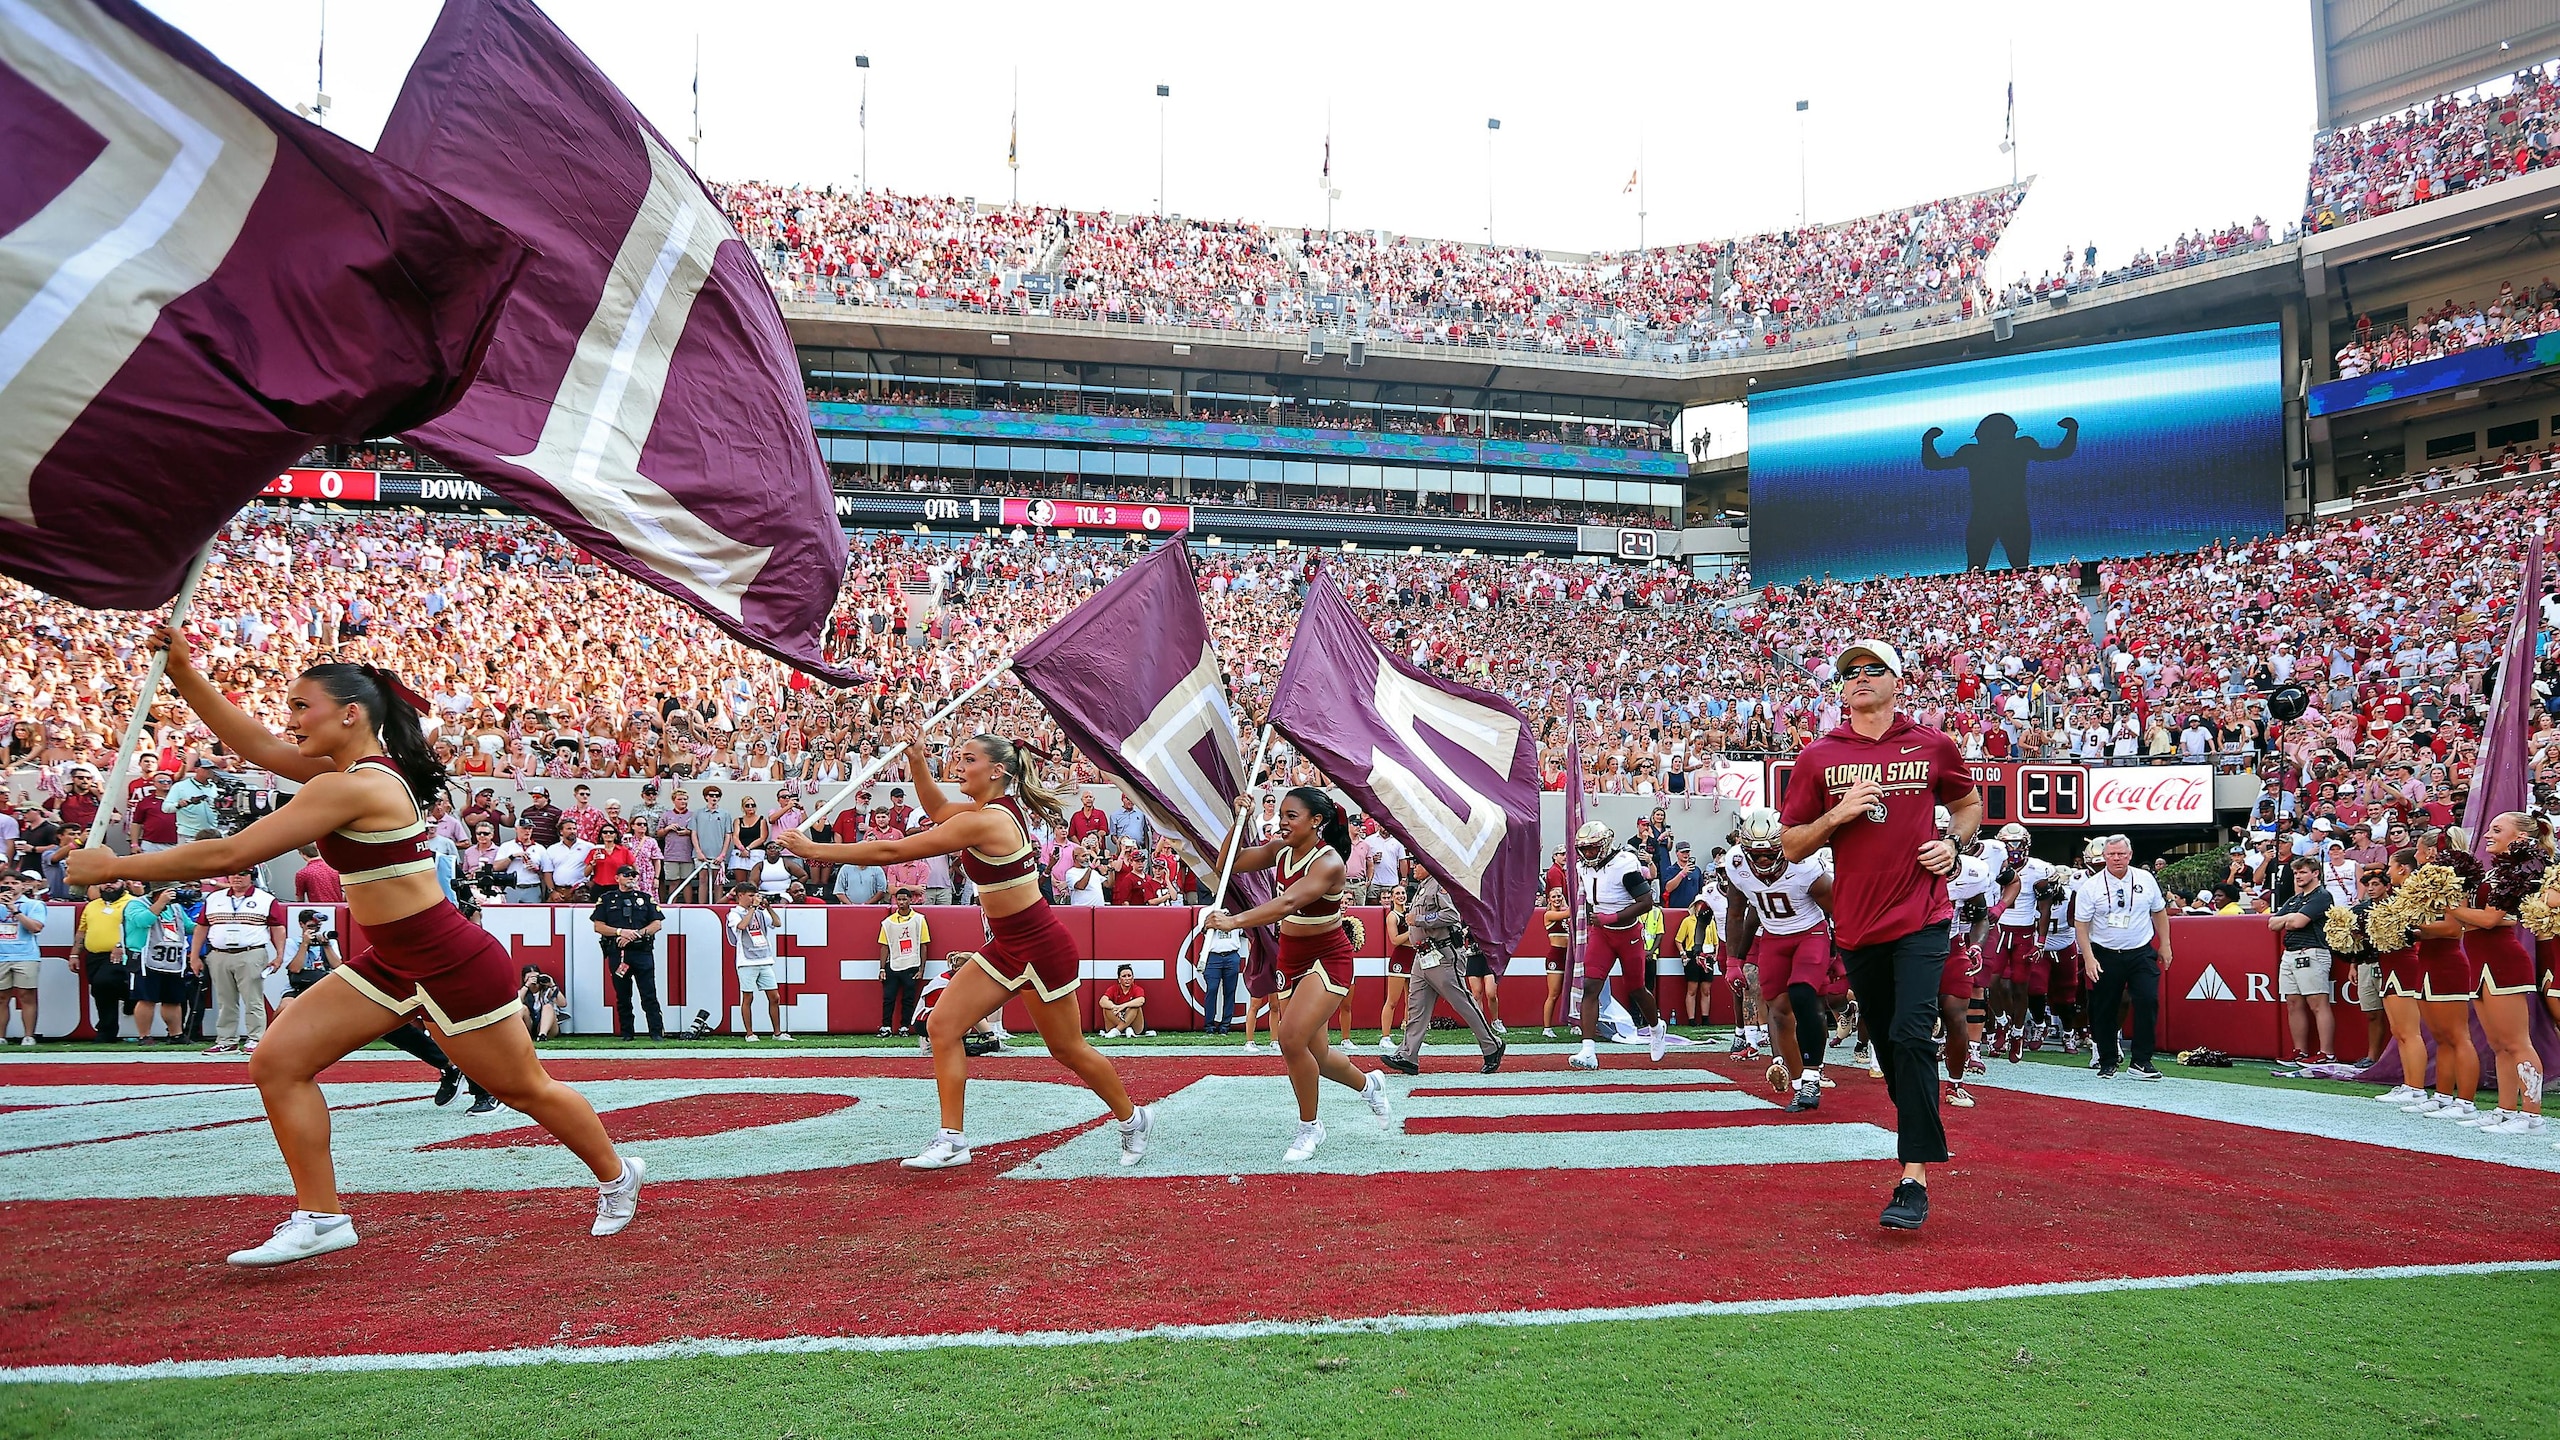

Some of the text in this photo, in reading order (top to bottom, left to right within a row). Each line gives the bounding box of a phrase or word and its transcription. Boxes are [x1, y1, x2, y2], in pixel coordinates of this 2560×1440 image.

[319, 471, 344, 499] 0
[420, 478, 482, 500] DOWN
[924, 499, 960, 520] QTR
[969, 499, 981, 522] 1
[1075, 506, 1161, 530] TOL 3 0
[1624, 533, 1651, 554] 24
[2090, 735, 2098, 747] 9
[1824, 761, 1930, 787] FLORIDA STATE
[1969, 767, 2001, 782] TO GO
[2028, 773, 2077, 811] 24
[2093, 777, 2208, 812] Coca-Cola
[1754, 892, 1796, 919] 10
